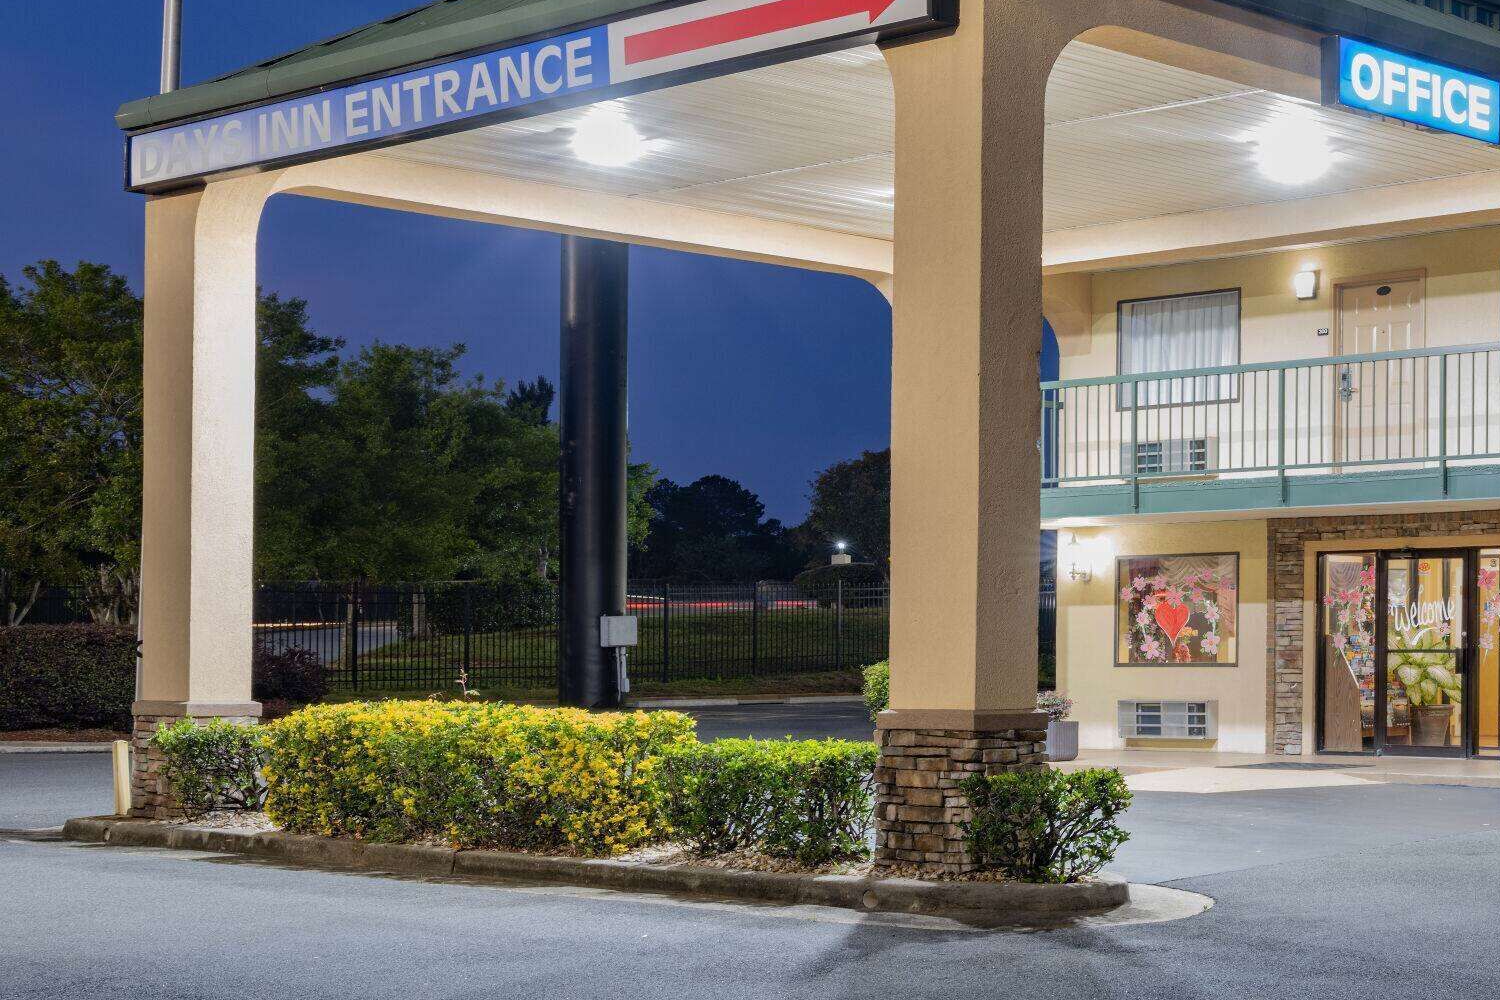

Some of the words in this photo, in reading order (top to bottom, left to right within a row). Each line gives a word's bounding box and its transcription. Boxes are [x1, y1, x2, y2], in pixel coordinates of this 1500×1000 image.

[139, 118, 244, 182] DAYS
[257, 103, 332, 157] INN
[345, 35, 595, 138] ENTRANCE
[1350, 52, 1491, 131] OFFICE
[1388, 584, 1456, 633] Welcome
